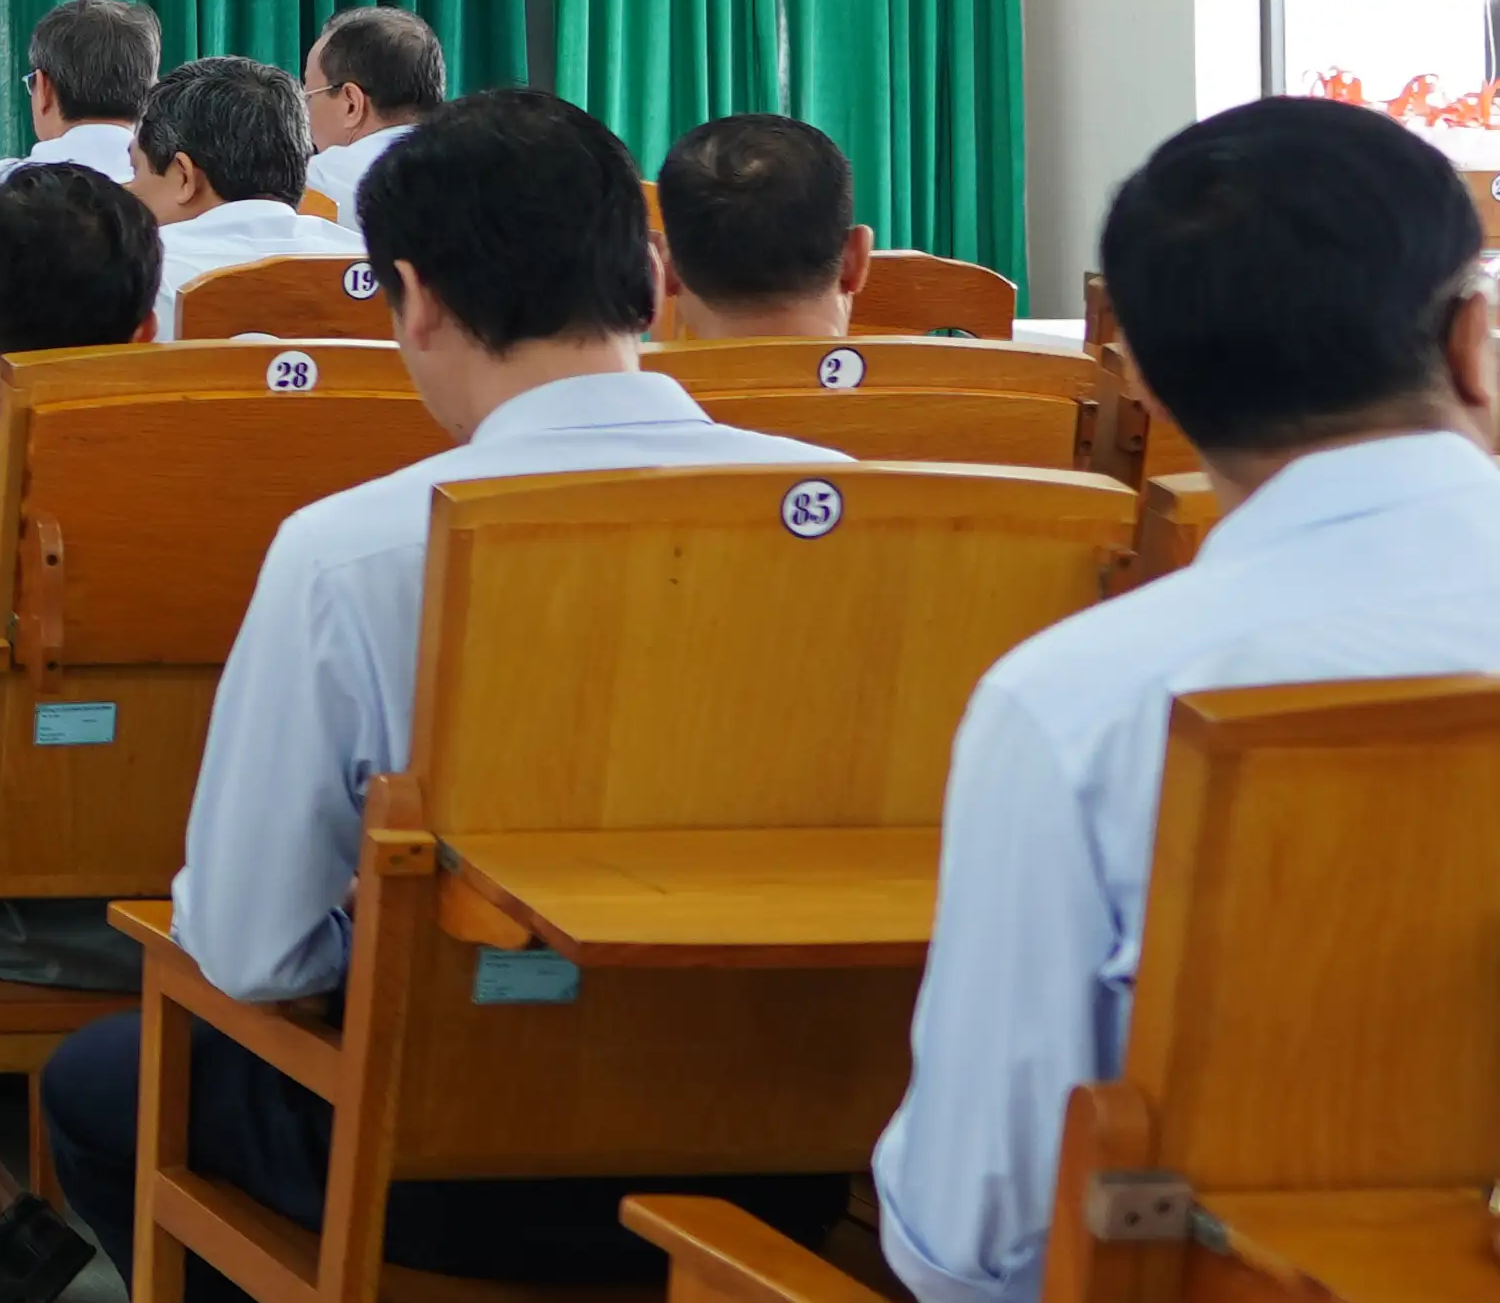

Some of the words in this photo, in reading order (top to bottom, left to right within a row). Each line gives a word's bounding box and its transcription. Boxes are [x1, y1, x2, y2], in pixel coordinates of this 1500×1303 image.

[350, 270, 376, 293] 19
[275, 361, 309, 389] 28
[791, 492, 832, 526] 85
